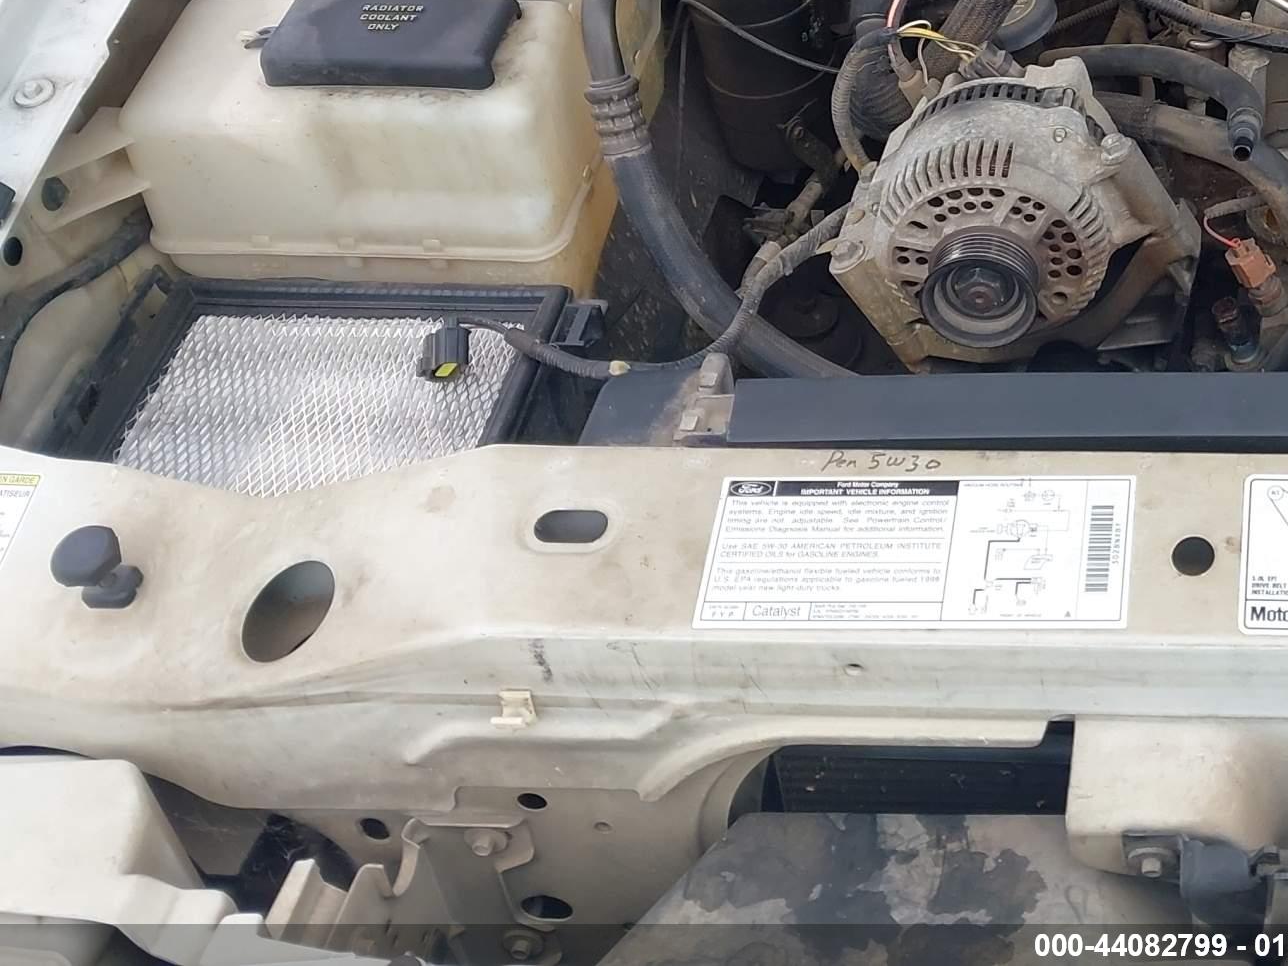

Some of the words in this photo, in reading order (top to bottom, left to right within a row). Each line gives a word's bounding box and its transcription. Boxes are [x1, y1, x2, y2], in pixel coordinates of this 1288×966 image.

[362, 4, 424, 12] RADIATOR
[360, 13, 416, 21] COOLANT
[738, 484, 763, 494] Ford
[871, 482, 898, 490] Company
[752, 606, 802, 619] Catalyst
